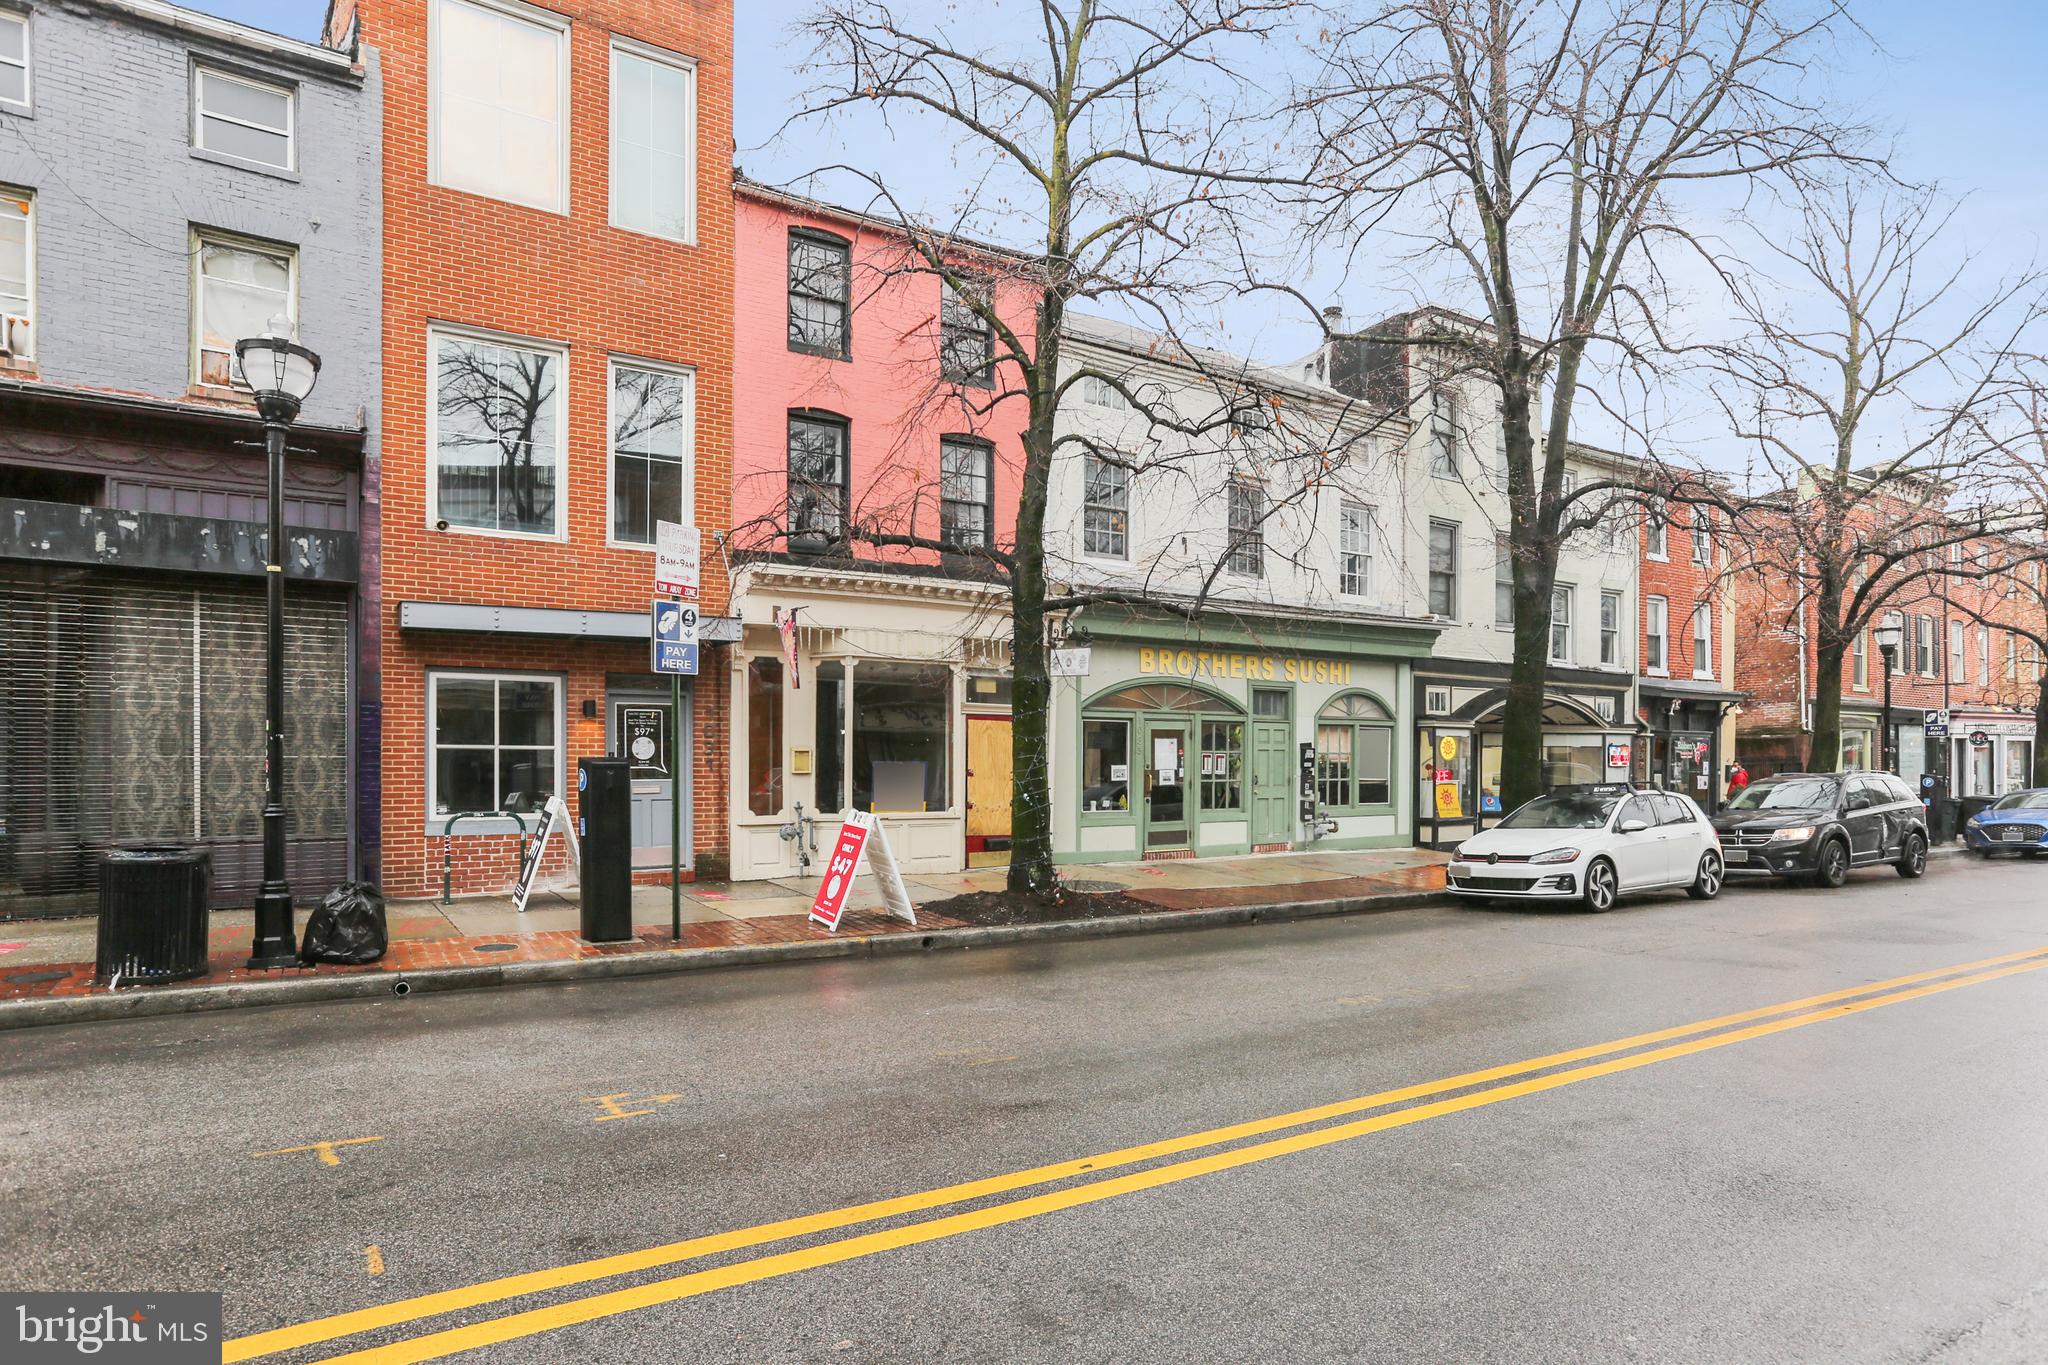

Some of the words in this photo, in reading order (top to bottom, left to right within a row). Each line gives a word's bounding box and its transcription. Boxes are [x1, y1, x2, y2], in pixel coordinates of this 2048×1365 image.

[660, 555, 695, 569] 8AM-9AM
[665, 646, 687, 657] PAY
[661, 658, 692, 670] HERE
[1139, 646, 1275, 680] BROTHERS
[1284, 657, 1351, 685] SUSHI
[832, 854, 853, 876] $47
